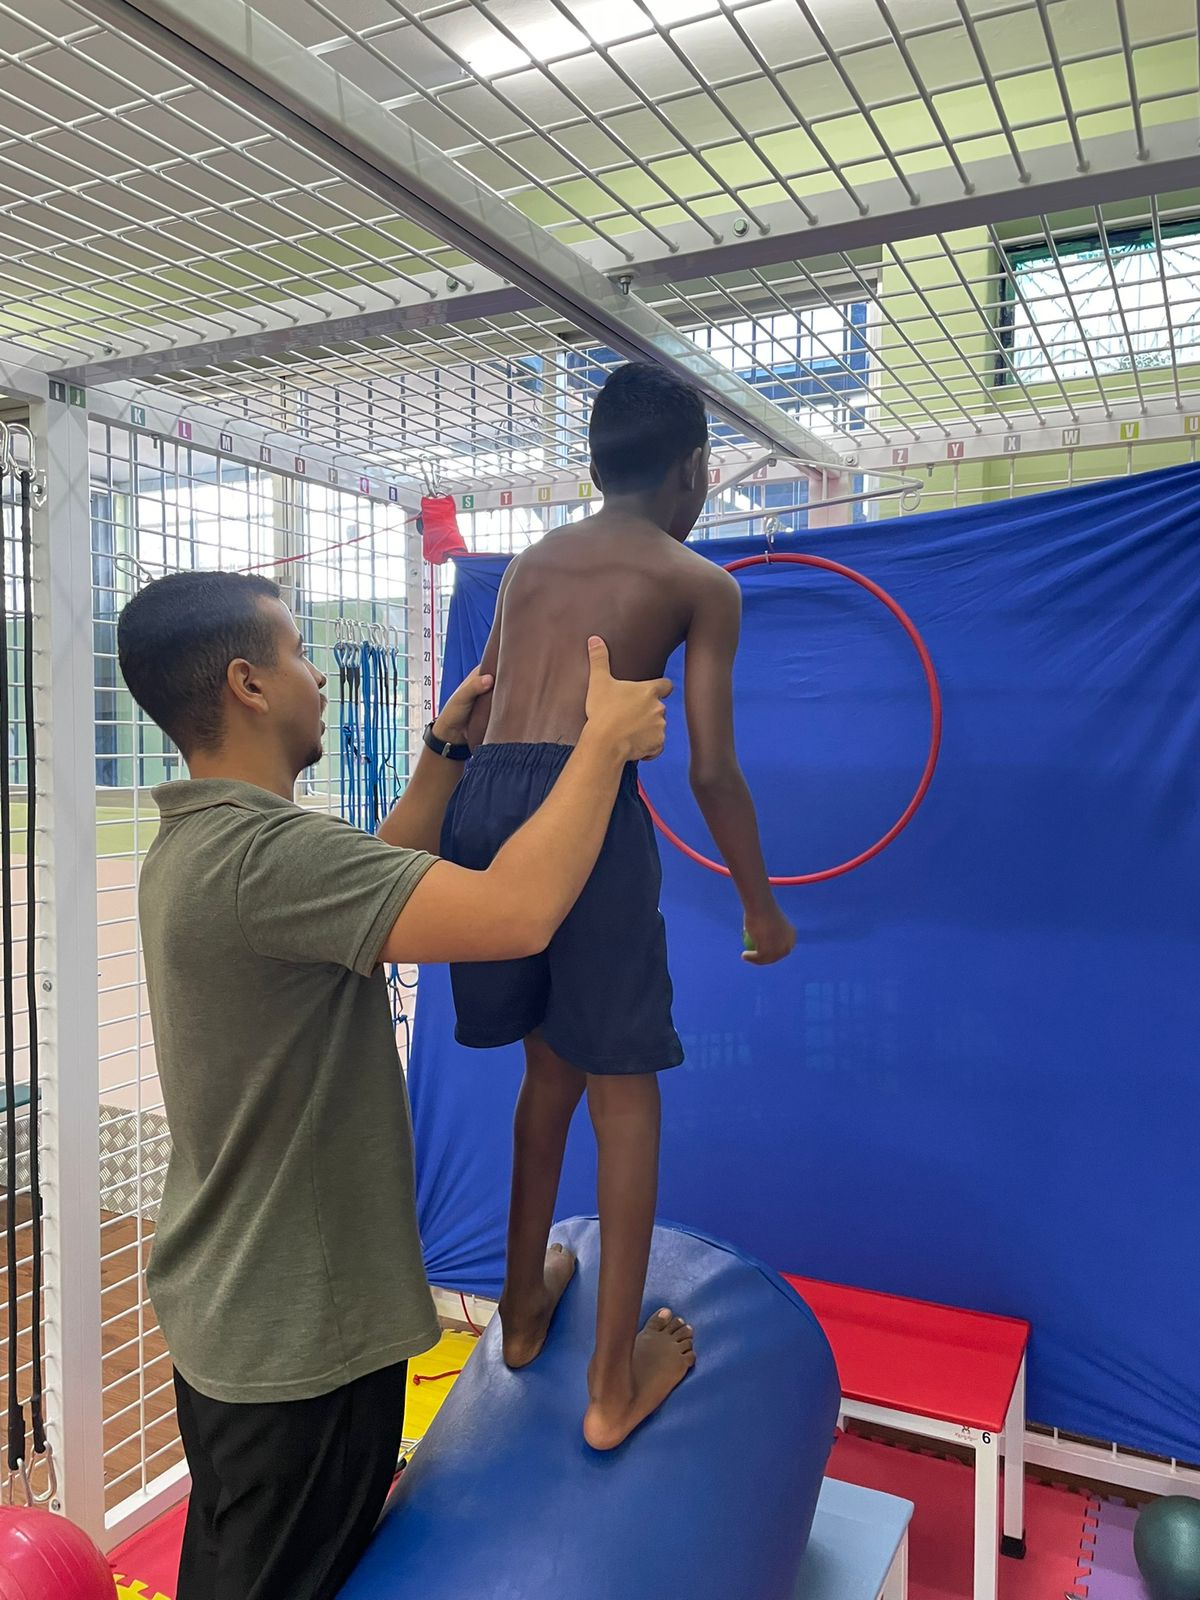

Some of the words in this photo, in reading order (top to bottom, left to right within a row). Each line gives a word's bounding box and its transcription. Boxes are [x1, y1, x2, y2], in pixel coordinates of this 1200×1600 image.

[134, 408, 142, 425] K
[182, 422, 189, 438] L
[223, 435, 230, 451] M
[262, 447, 269, 462] N
[897, 450, 904, 463] Z
[951, 443, 960, 457] Y
[1007, 437, 1016, 451] X
[1063, 430, 1078, 445] W
[1125, 423, 1135, 437] V
[1189, 417, 1199, 432] U
[465, 496, 471, 508] S
[503, 492, 509, 504] T
[541, 488, 547, 500] U
[581, 483, 589, 496] V
[710, 470, 717, 483] Y
[423, 603, 431, 614] 29
[423, 627, 431, 638] 28
[424, 651, 431, 662] 27
[424, 675, 431, 686] 26
[424, 699, 431, 710] 25
[982, 1431, 991, 1444] 6
